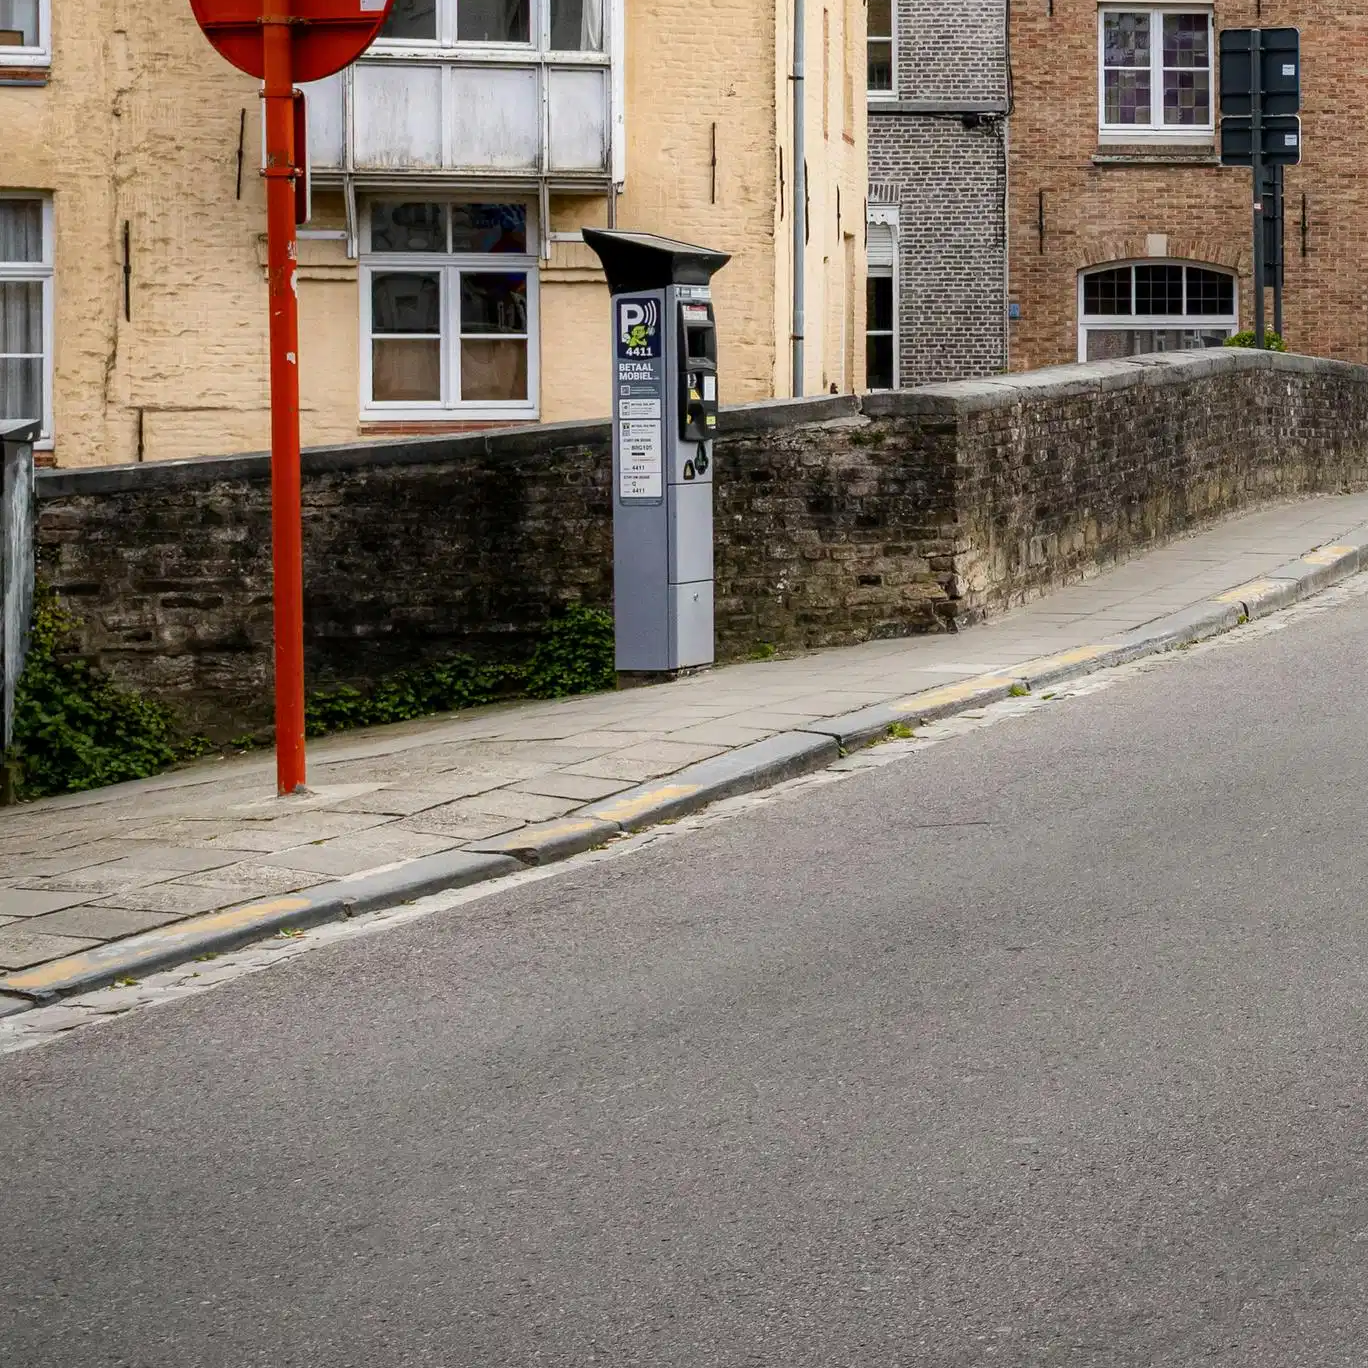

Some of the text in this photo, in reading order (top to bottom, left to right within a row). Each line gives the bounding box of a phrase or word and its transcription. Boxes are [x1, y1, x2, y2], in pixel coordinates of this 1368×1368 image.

[621, 303, 645, 343] P
[626, 347, 653, 356] 4411
[619, 363, 653, 372] BETAAL
[619, 372, 653, 380] MOBIEL
